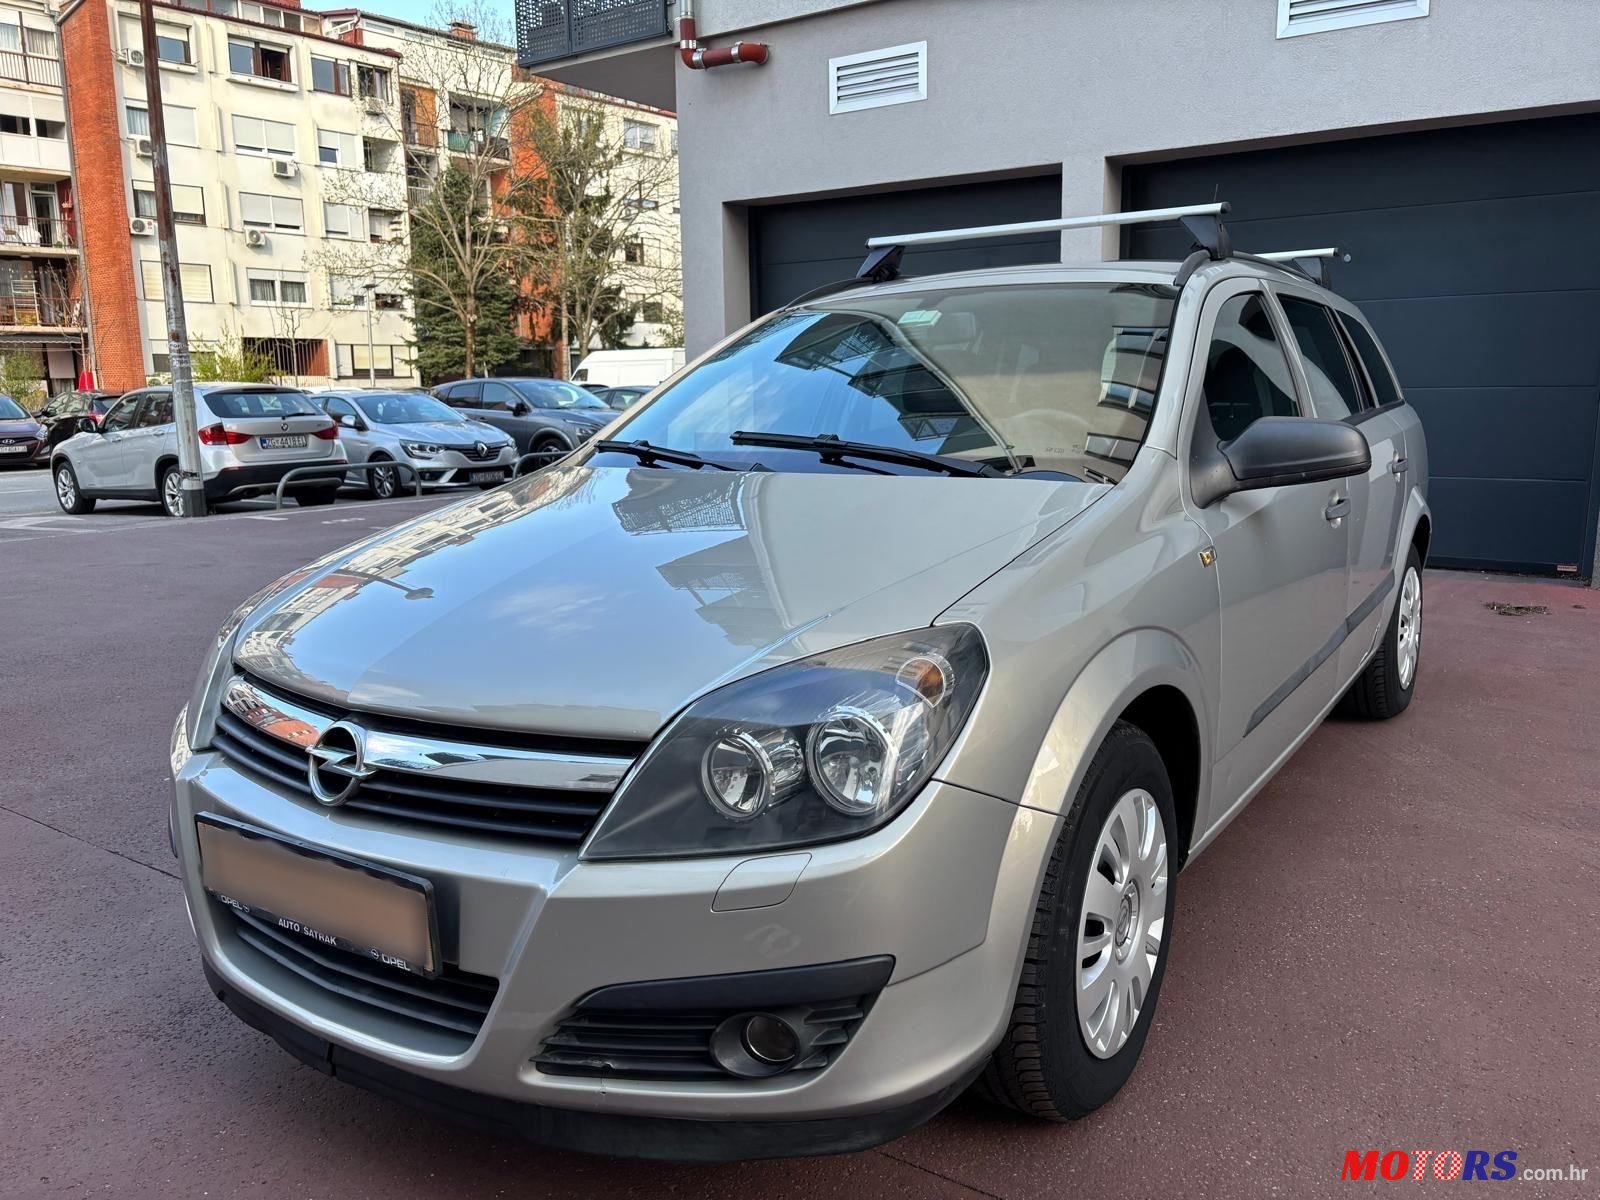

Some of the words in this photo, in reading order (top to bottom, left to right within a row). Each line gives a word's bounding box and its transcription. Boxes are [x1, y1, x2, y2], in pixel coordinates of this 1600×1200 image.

[220, 895, 243, 910] OPEL
[278, 917, 300, 932] AUTO
[303, 926, 337, 946] SATRAK
[381, 953, 411, 972] OPEL
